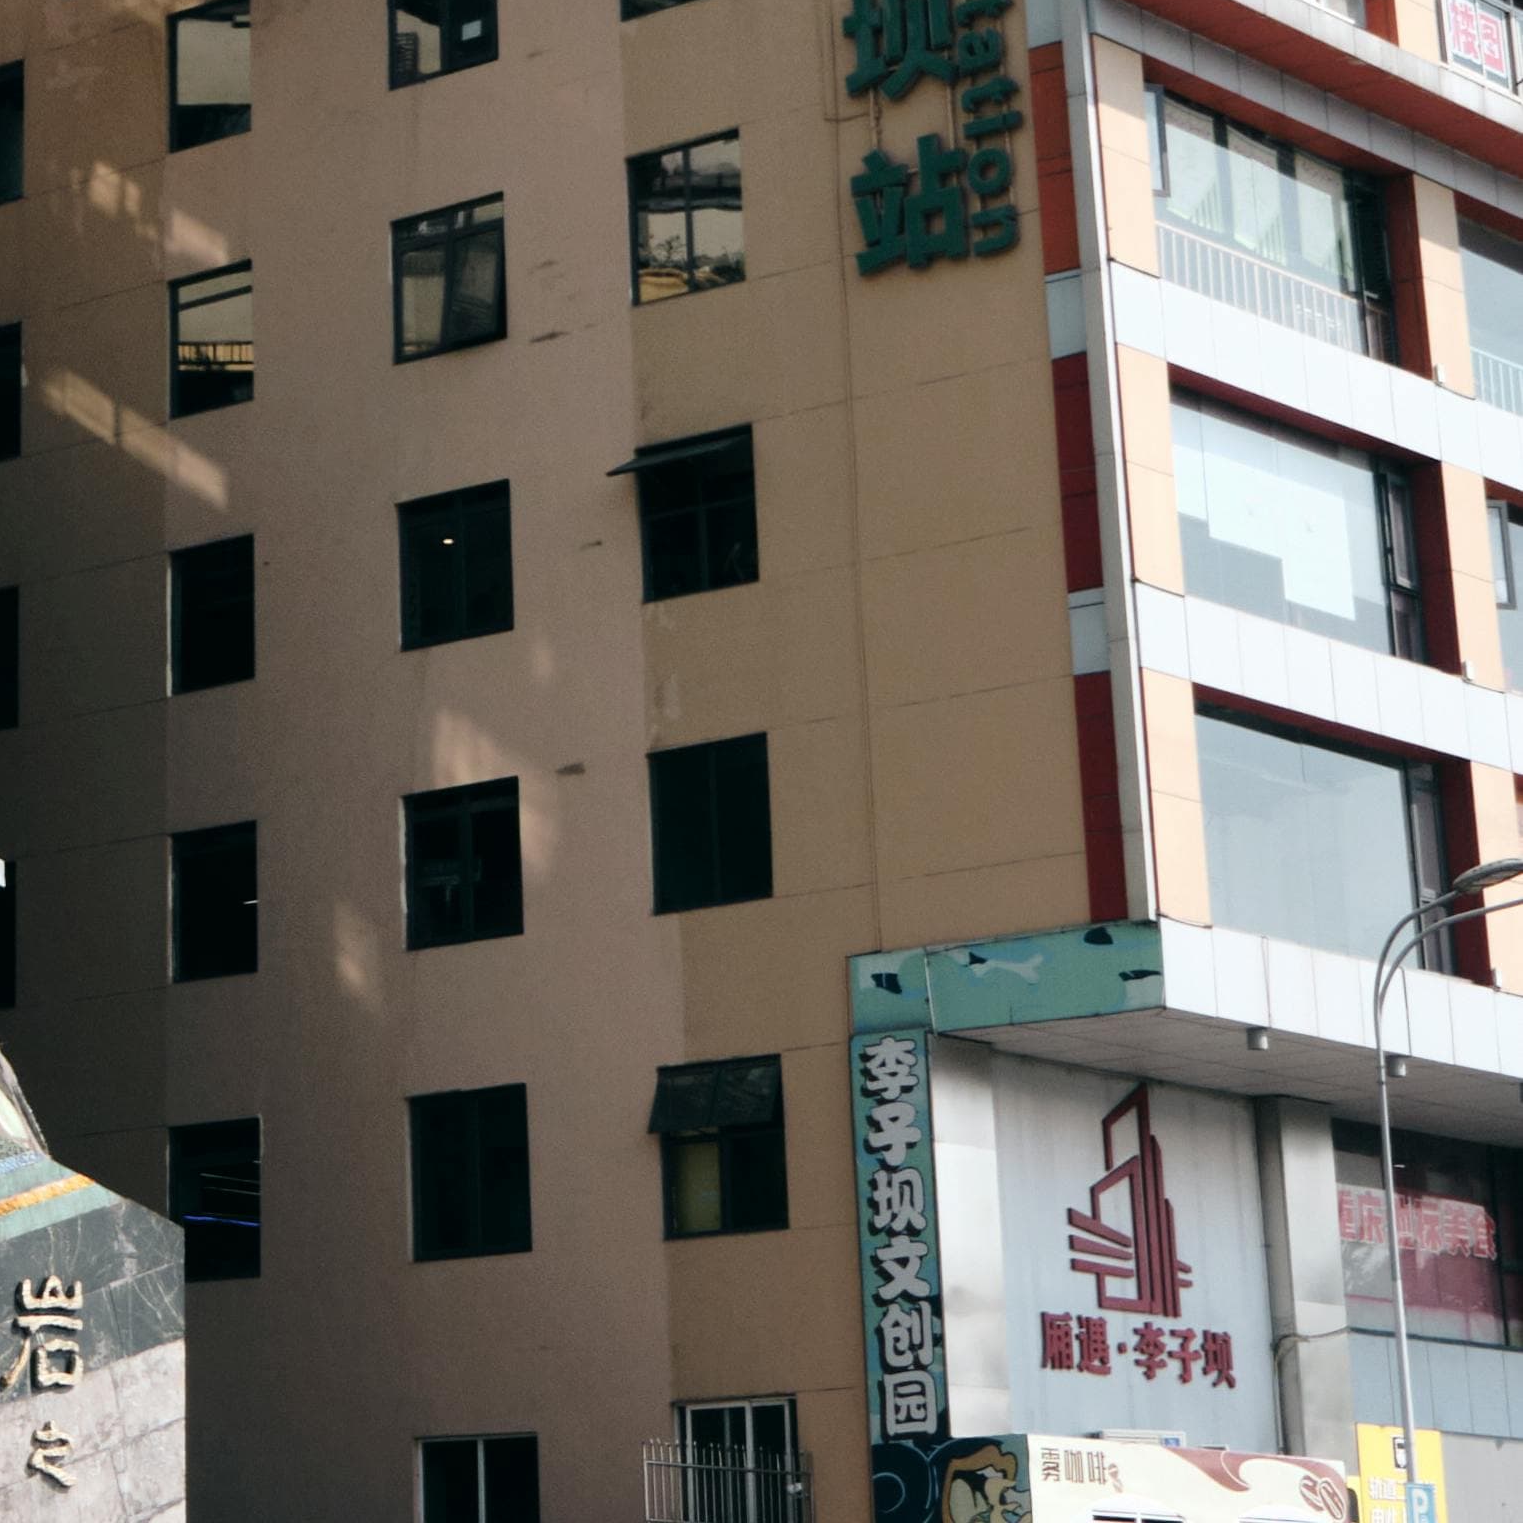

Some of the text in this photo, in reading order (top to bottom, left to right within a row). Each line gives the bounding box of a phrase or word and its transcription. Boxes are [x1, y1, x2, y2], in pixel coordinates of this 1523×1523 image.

[861, 1034, 938, 1439] 李子坝文创园
